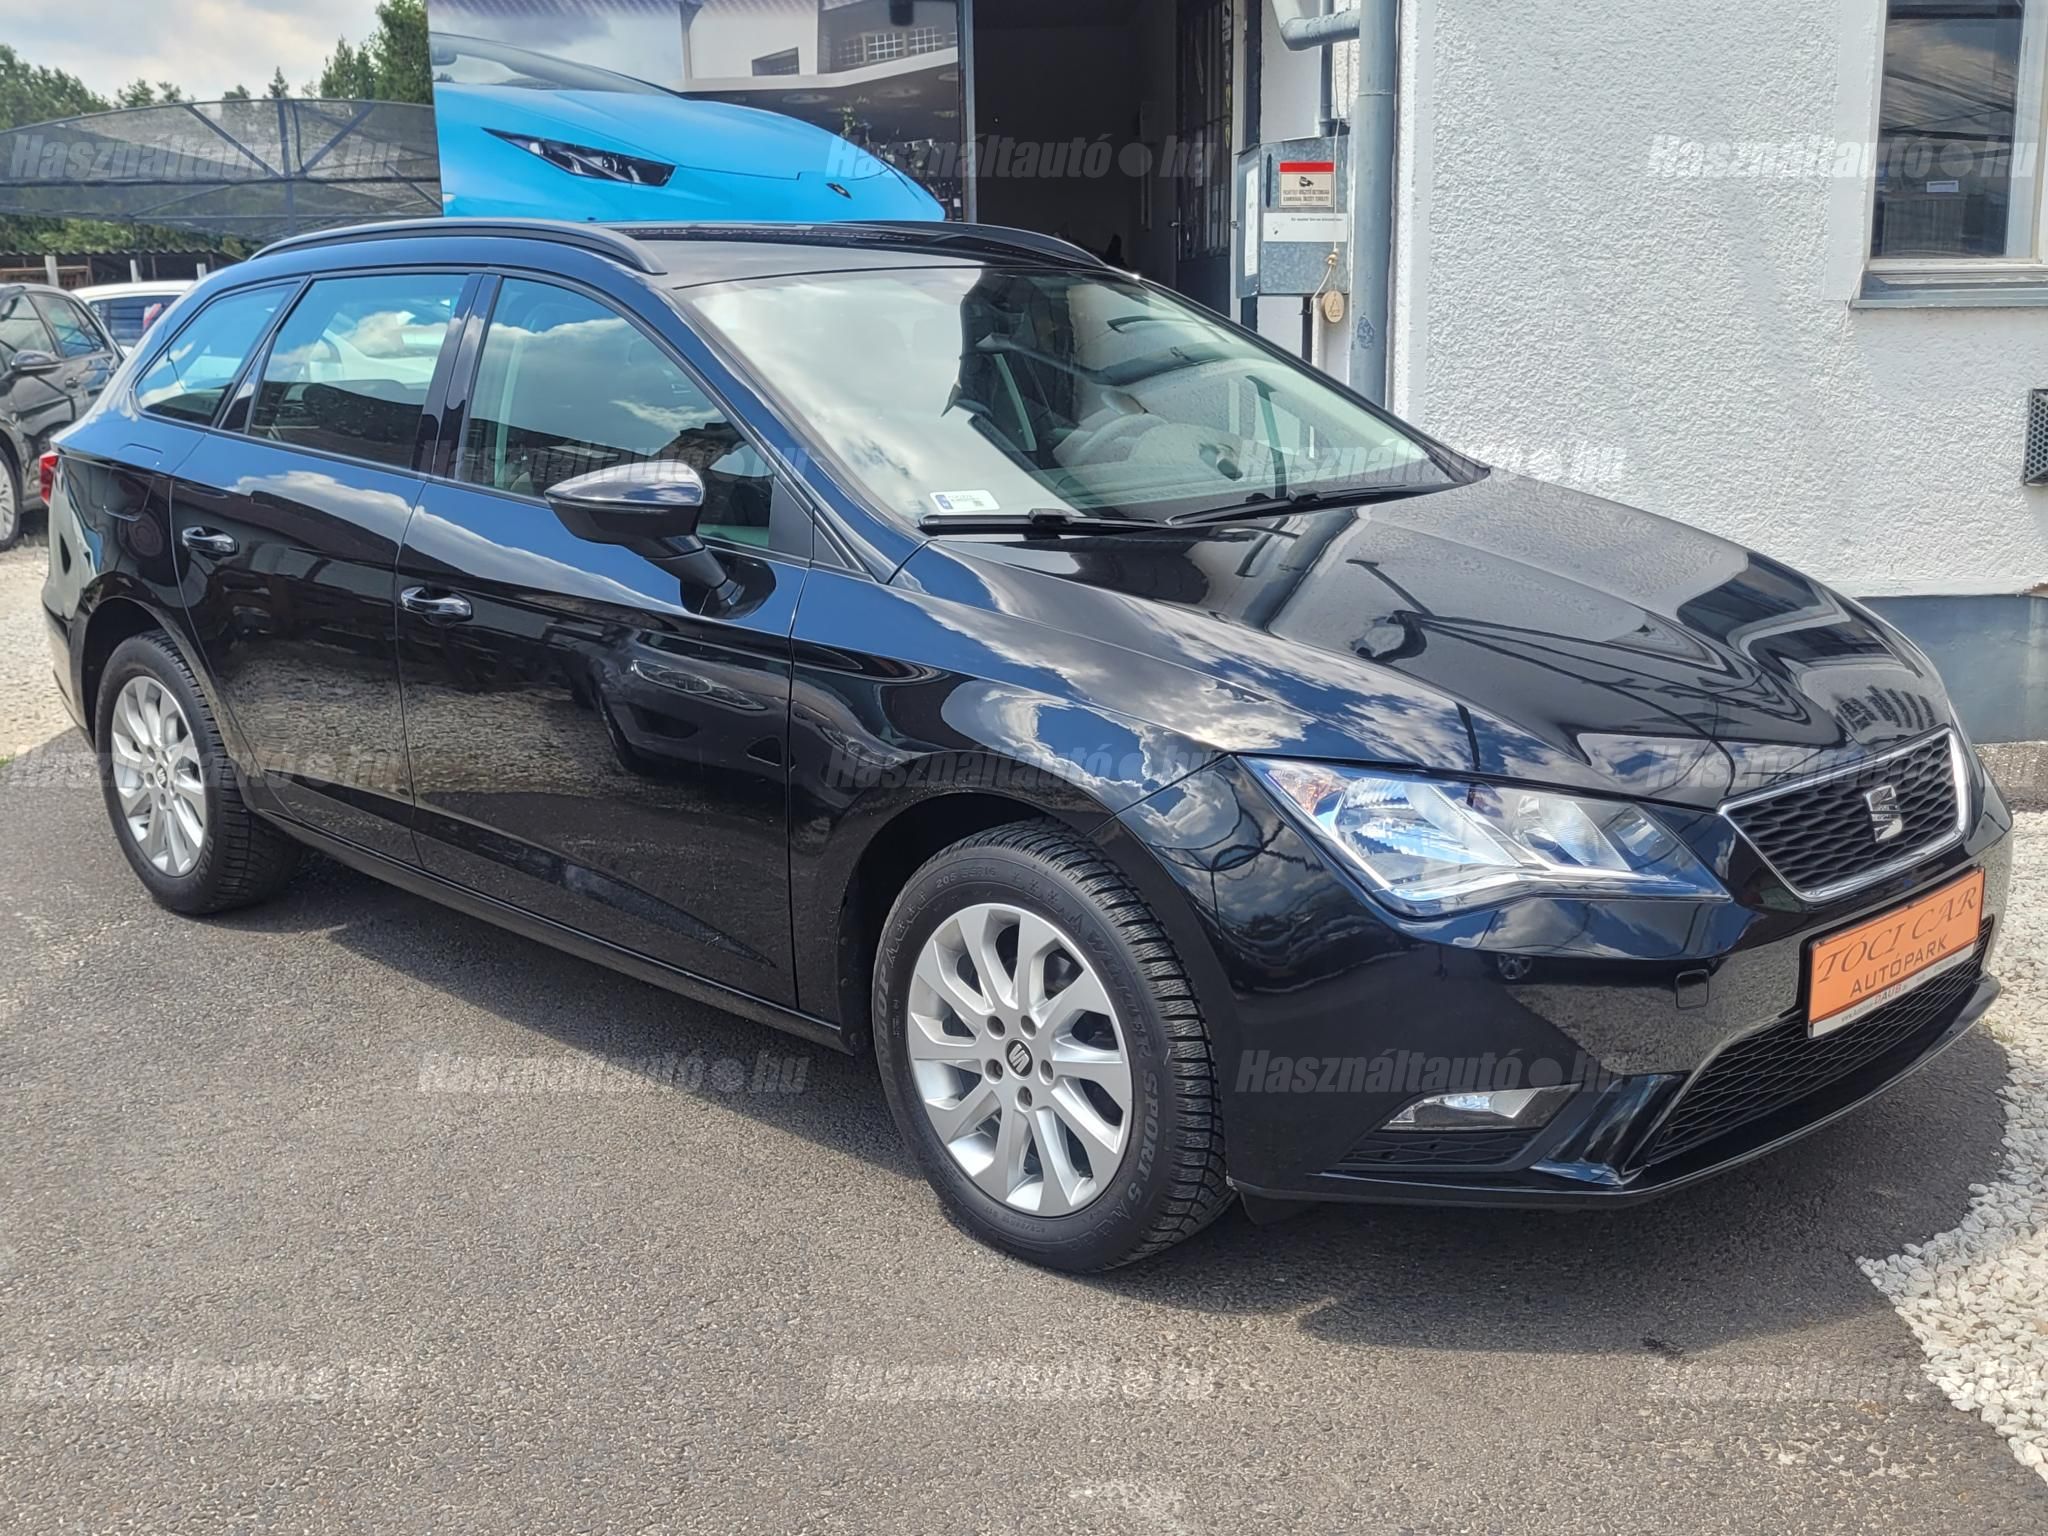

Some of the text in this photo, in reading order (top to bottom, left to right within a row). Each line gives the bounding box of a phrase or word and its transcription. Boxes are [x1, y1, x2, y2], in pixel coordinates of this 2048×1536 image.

[1817, 923, 1905, 984] TÓCI
[1911, 886, 1977, 939] CAR
[1850, 934, 1947, 998] AUTÓPARK
[1137, 1071, 1159, 1182] SPORT
